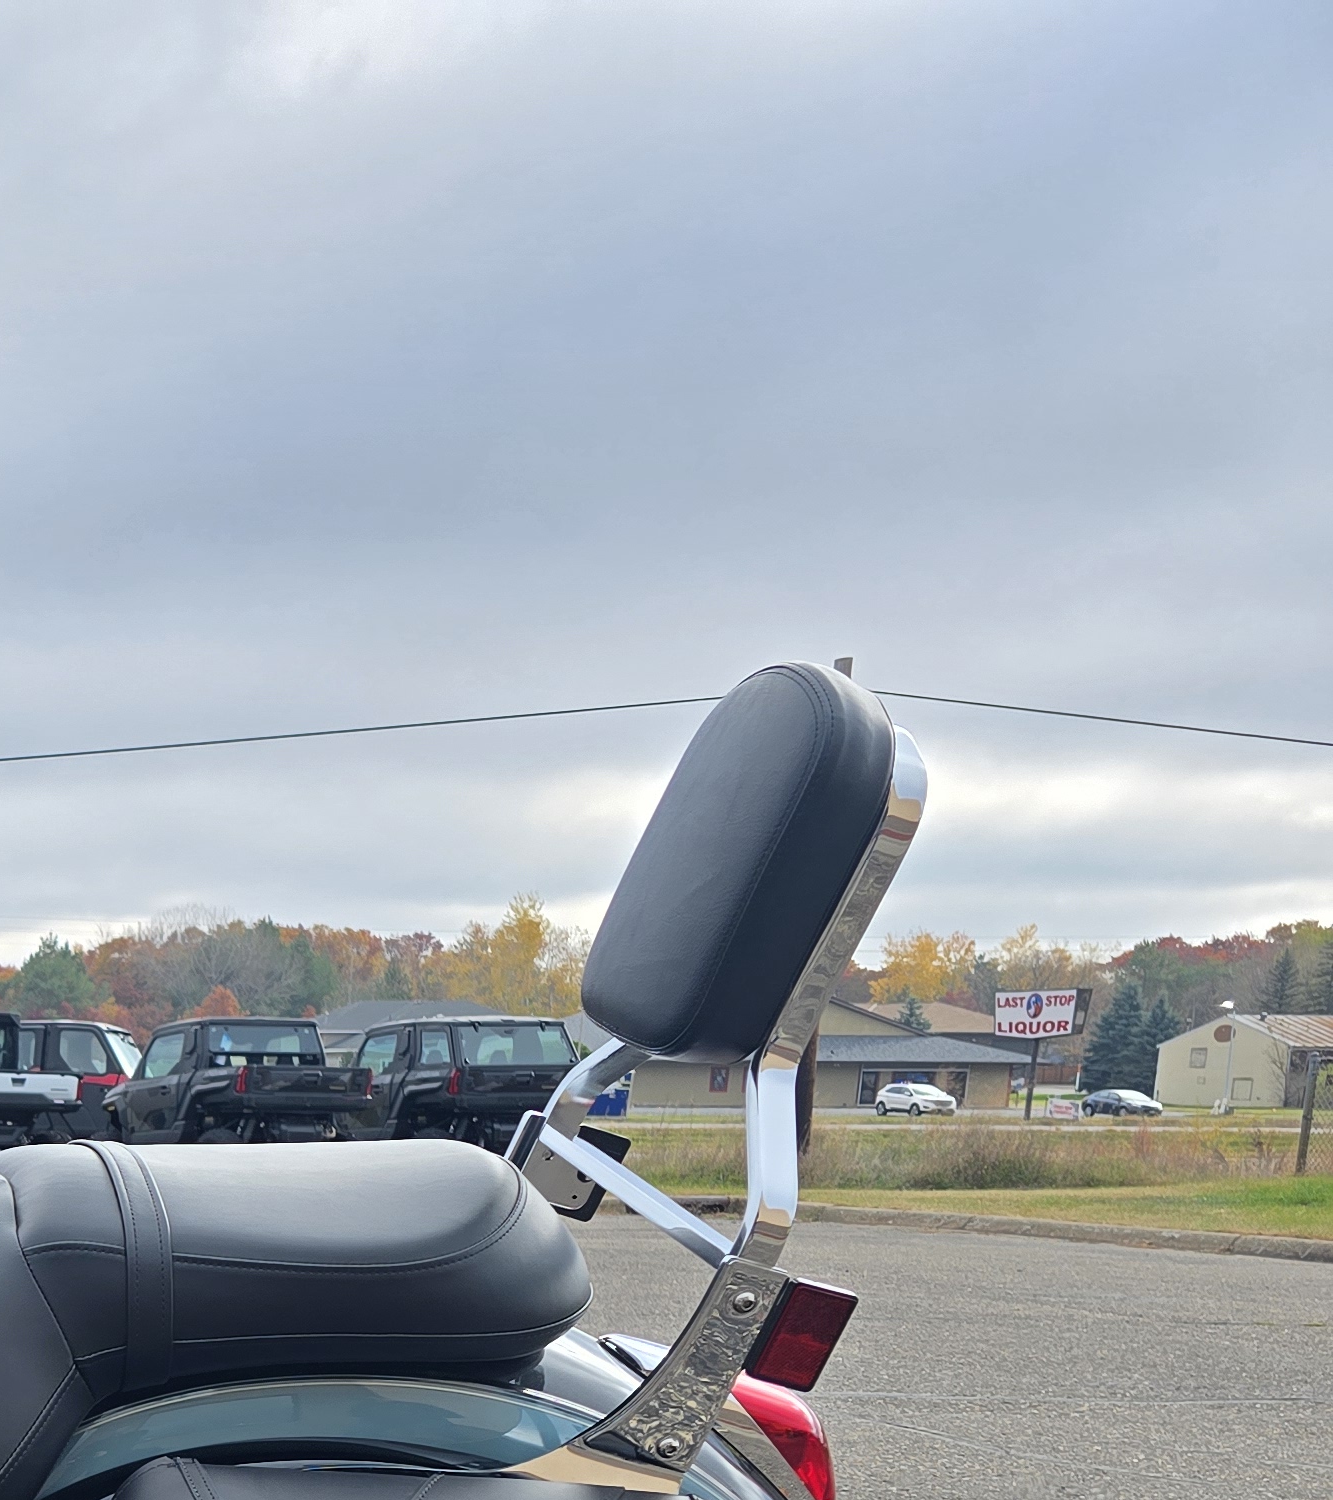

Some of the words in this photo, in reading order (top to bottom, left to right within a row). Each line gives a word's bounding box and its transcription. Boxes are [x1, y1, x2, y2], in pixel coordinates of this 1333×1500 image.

[997, 996, 1025, 1008] LAST
[1045, 994, 1075, 1007] STOP
[997, 1020, 1069, 1035] LIQUOR
